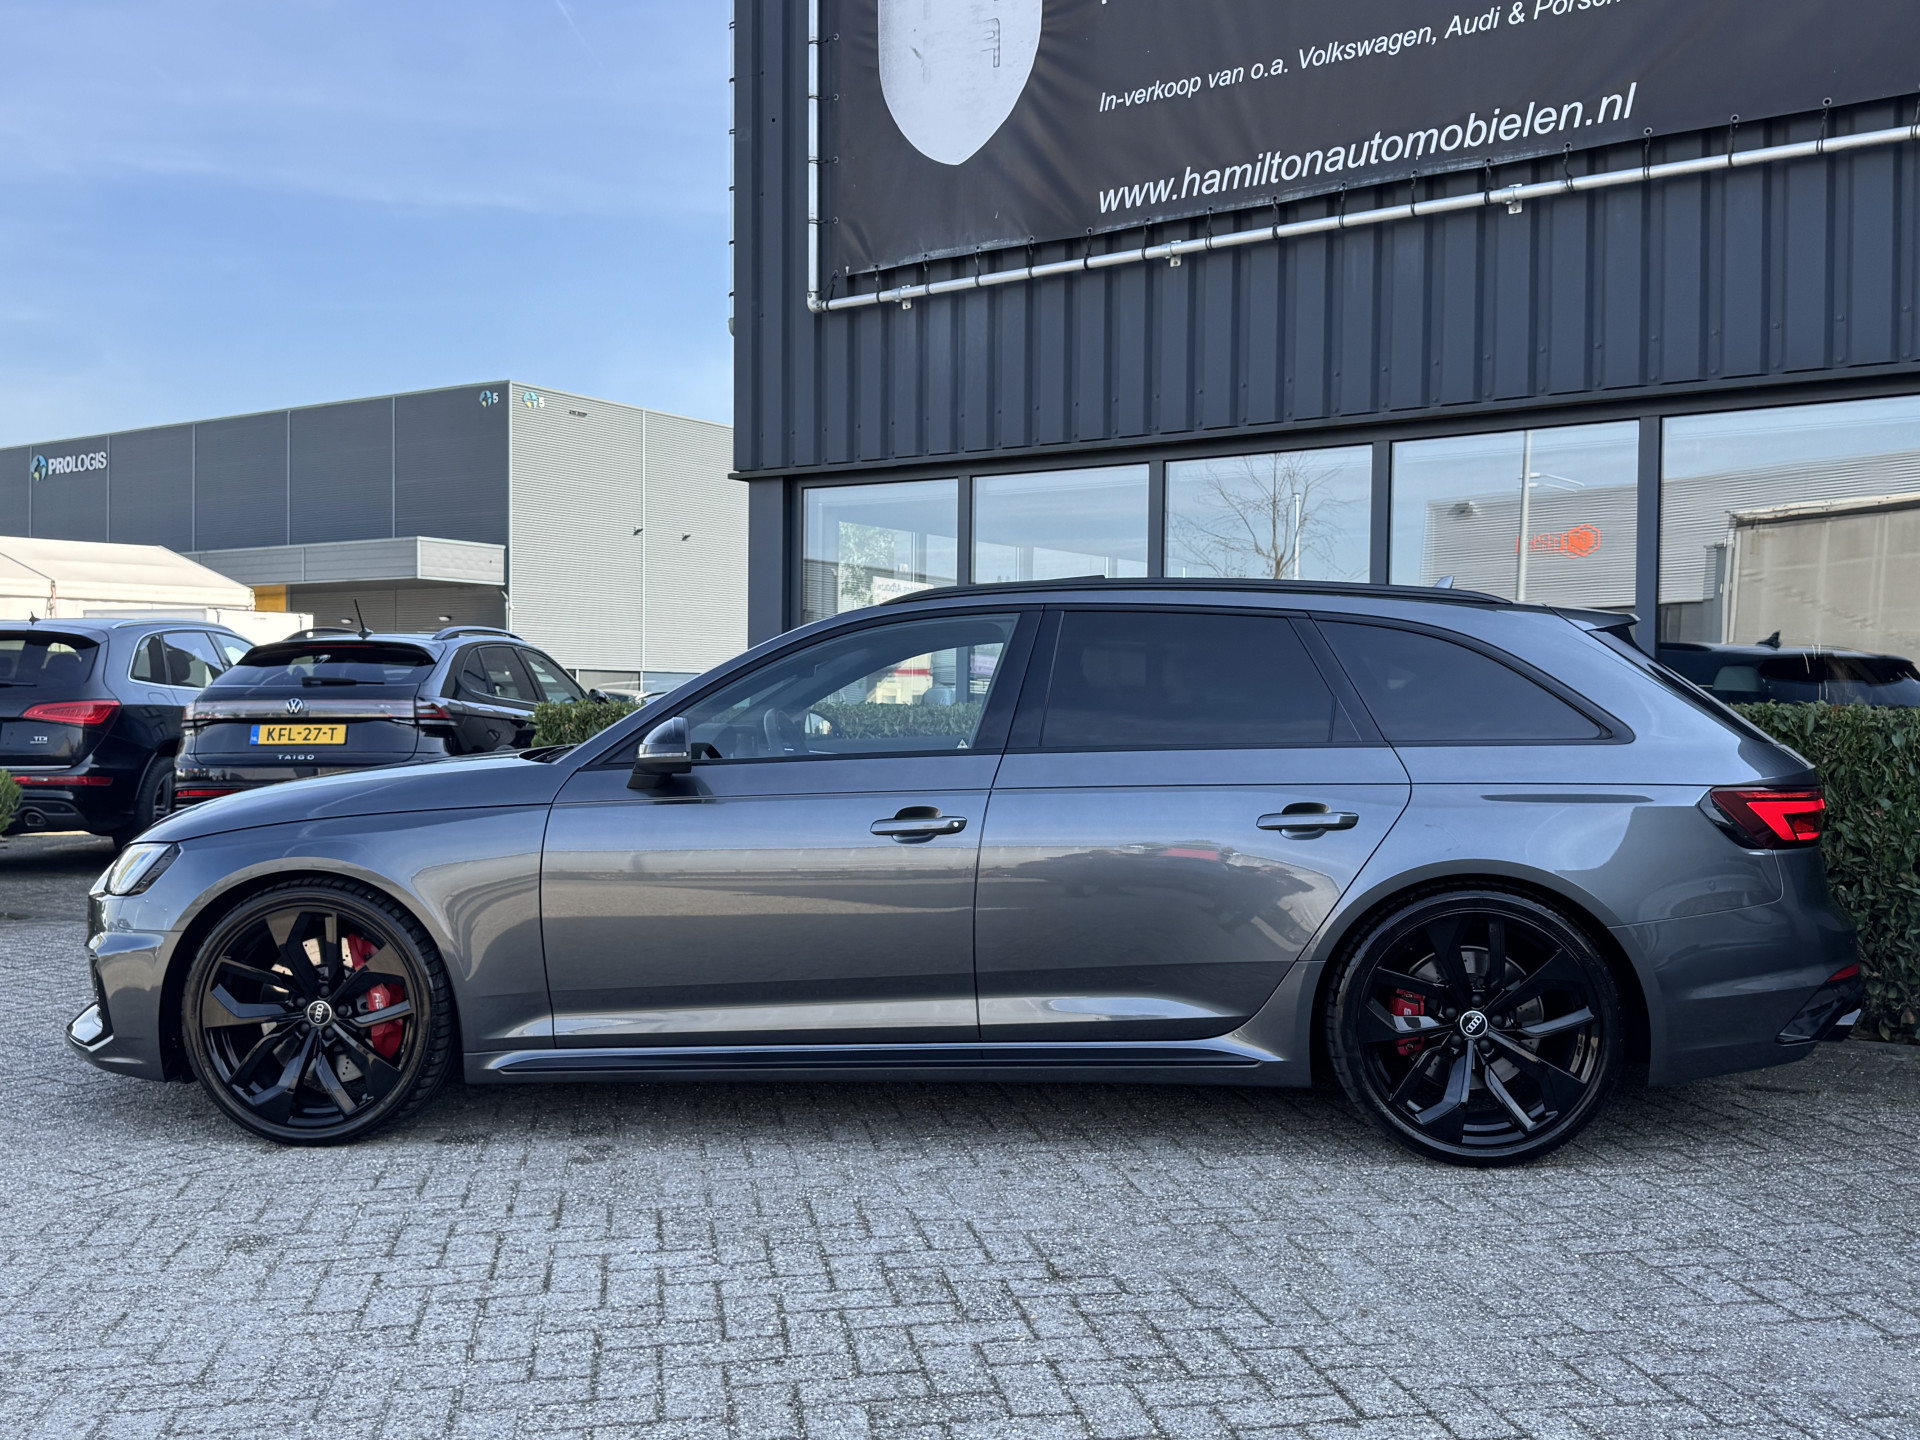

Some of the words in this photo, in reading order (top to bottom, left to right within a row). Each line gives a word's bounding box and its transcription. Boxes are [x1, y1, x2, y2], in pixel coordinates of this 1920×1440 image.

[1099, 75, 1202, 112] In-verkoop
[1208, 66, 1244, 89] van
[1250, 58, 1289, 80] o.a.
[1298, 26, 1437, 70] Volkswagen,
[1444, 6, 1501, 39] Audi
[1507, 1, 1525, 25] &
[1099, 82, 1637, 214] www.hamiltonautomobielen.nl
[492, 392, 499, 403] 5
[538, 396, 545, 408] 5
[48, 451, 107, 475] PROLOGIS
[266, 727, 338, 742] KFL-27-T
